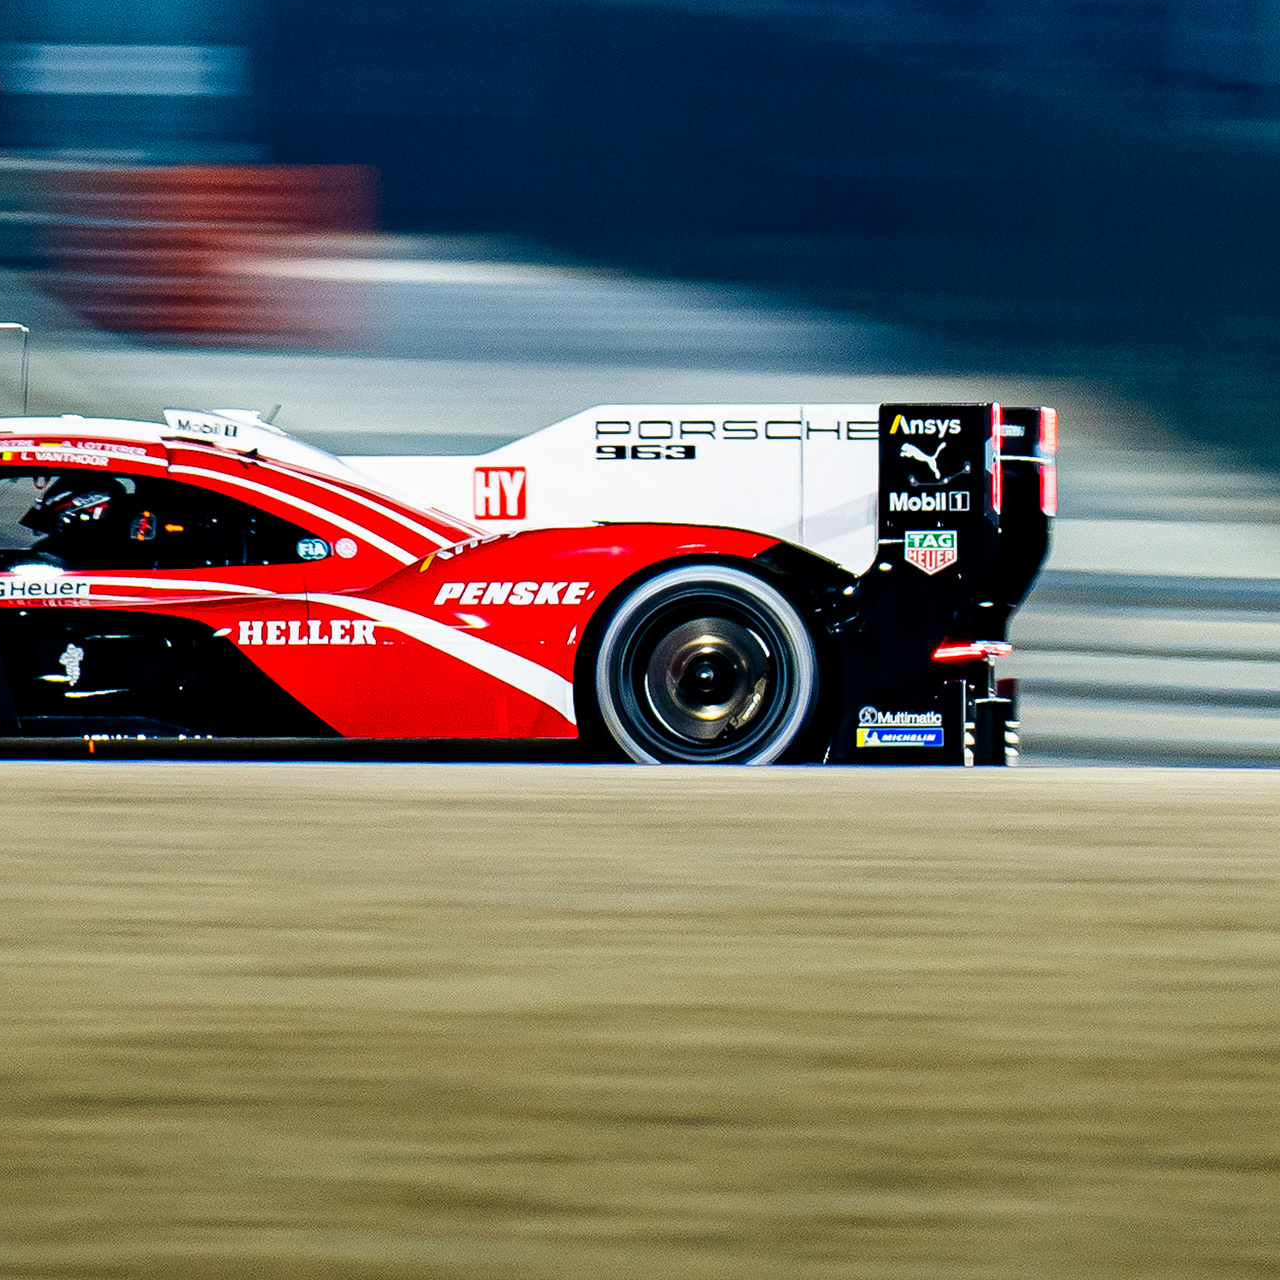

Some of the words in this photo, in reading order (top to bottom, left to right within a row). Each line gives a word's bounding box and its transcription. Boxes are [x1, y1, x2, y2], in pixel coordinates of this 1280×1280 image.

[595, 420, 879, 440] PORSCHE
[889, 414, 962, 438] Ansys
[35, 451, 110, 466] VANTHOOR
[595, 445, 696, 460] 963
[474, 470, 525, 517] HY
[889, 492, 947, 511] Mobil
[952, 492, 965, 511] 1
[299, 541, 327, 557] FIA
[909, 534, 953, 549] TAG
[907, 549, 954, 569] HEUER
[433, 581, 590, 605] PENSKE
[237, 619, 377, 645] HELLER
[877, 711, 942, 724] Multimatic
[881, 733, 936, 742] MICHELIN
